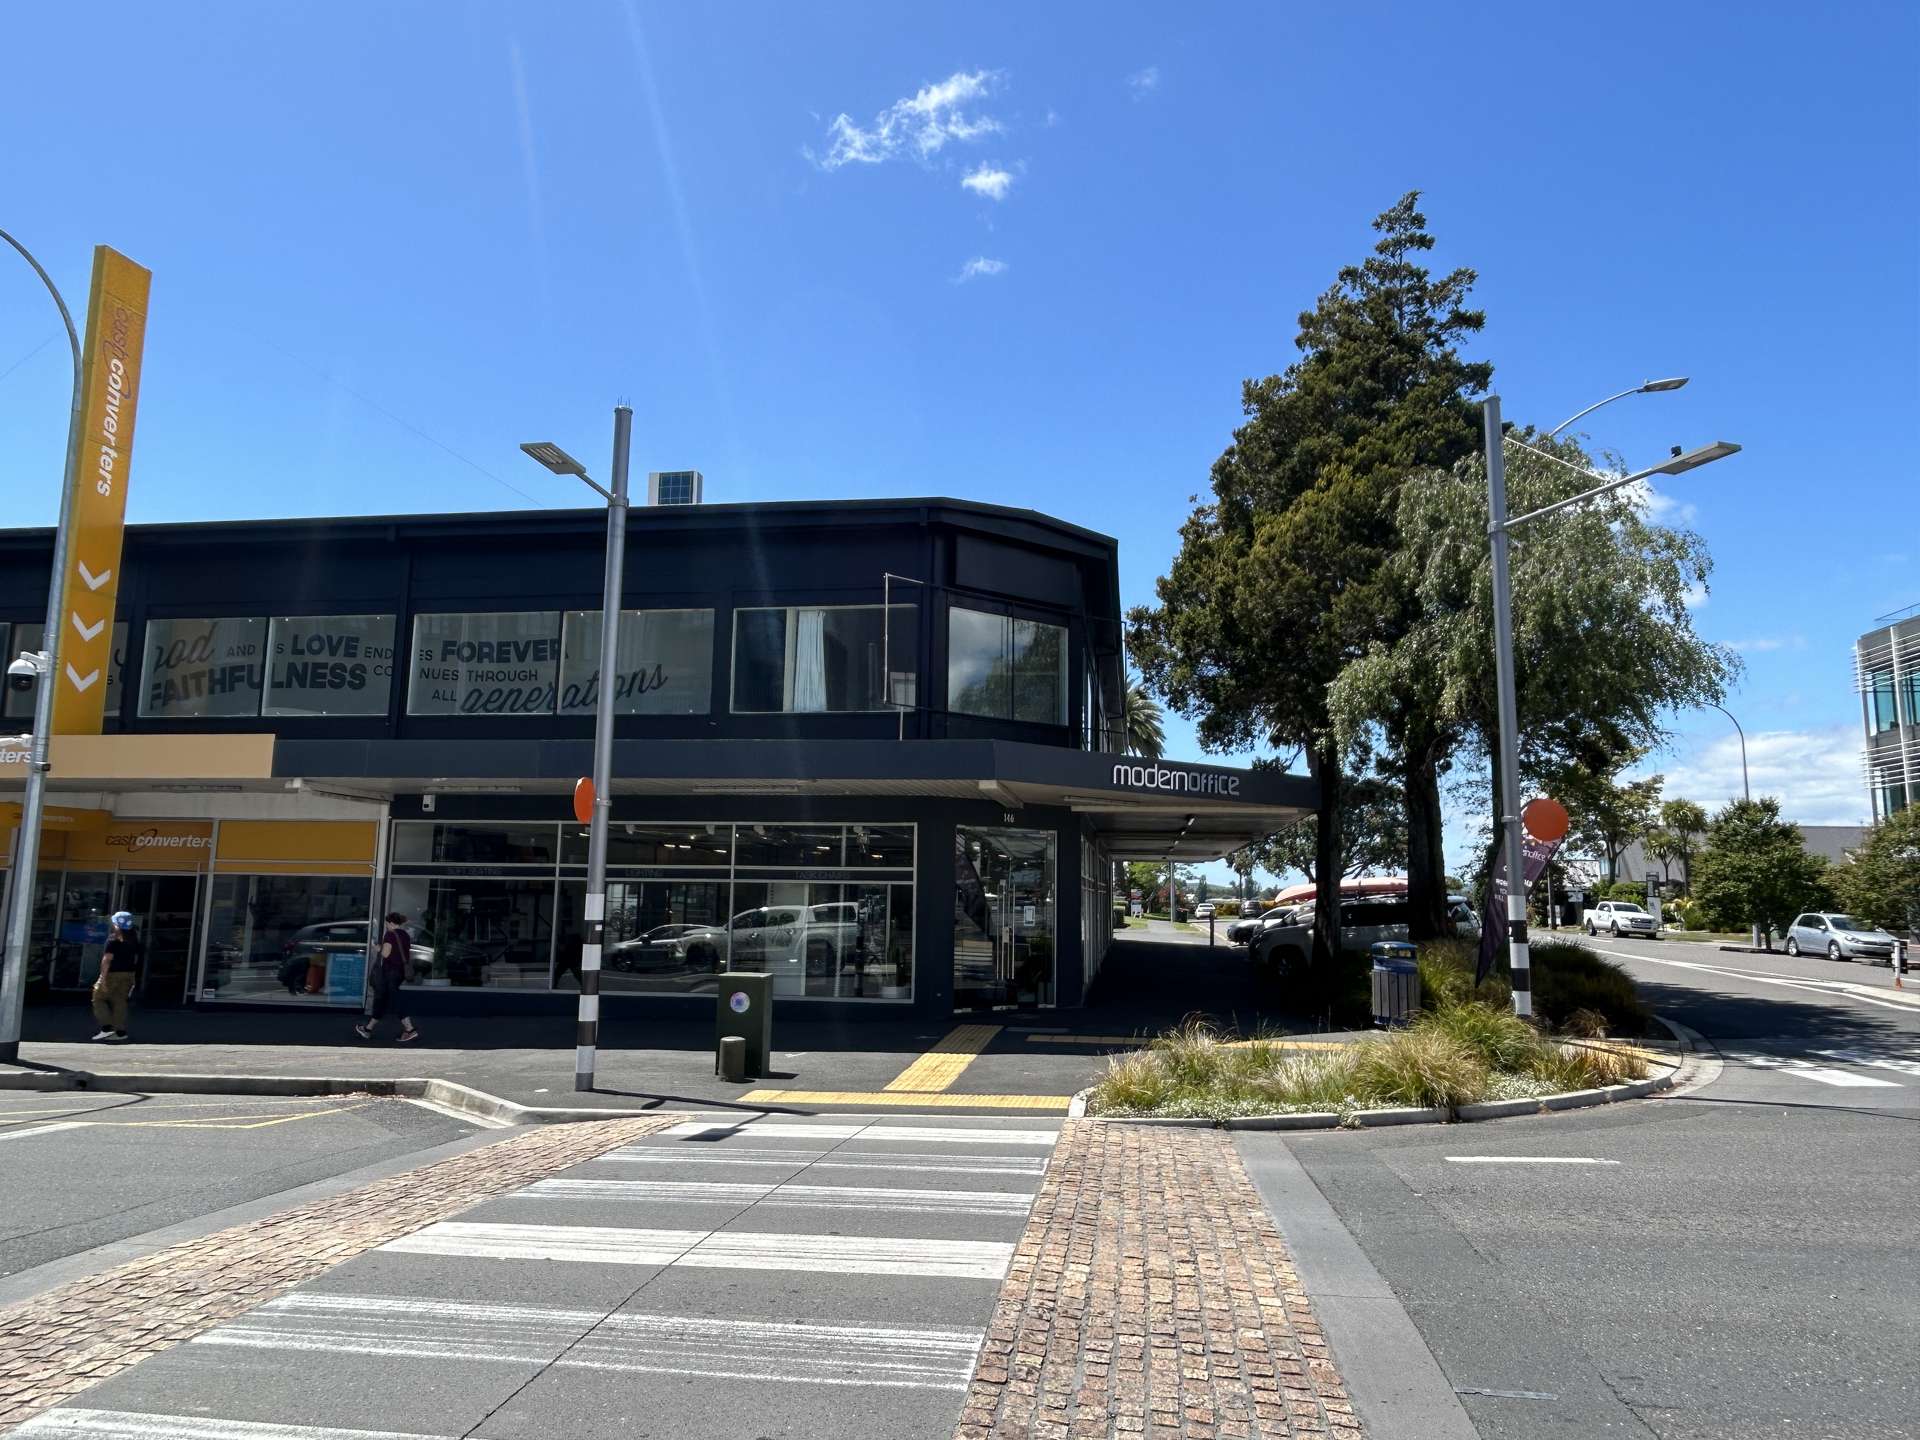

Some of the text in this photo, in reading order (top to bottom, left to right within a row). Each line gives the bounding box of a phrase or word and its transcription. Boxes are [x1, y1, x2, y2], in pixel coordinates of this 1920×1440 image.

[95, 357, 125, 497] converters
[226, 644, 257, 658] AND
[291, 633, 360, 658] LOVE
[441, 638, 569, 664] FOREVER
[150, 661, 367, 711] FAITHFULNESS
[467, 669, 538, 683] THROUGH
[431, 689, 457, 702] ALL
